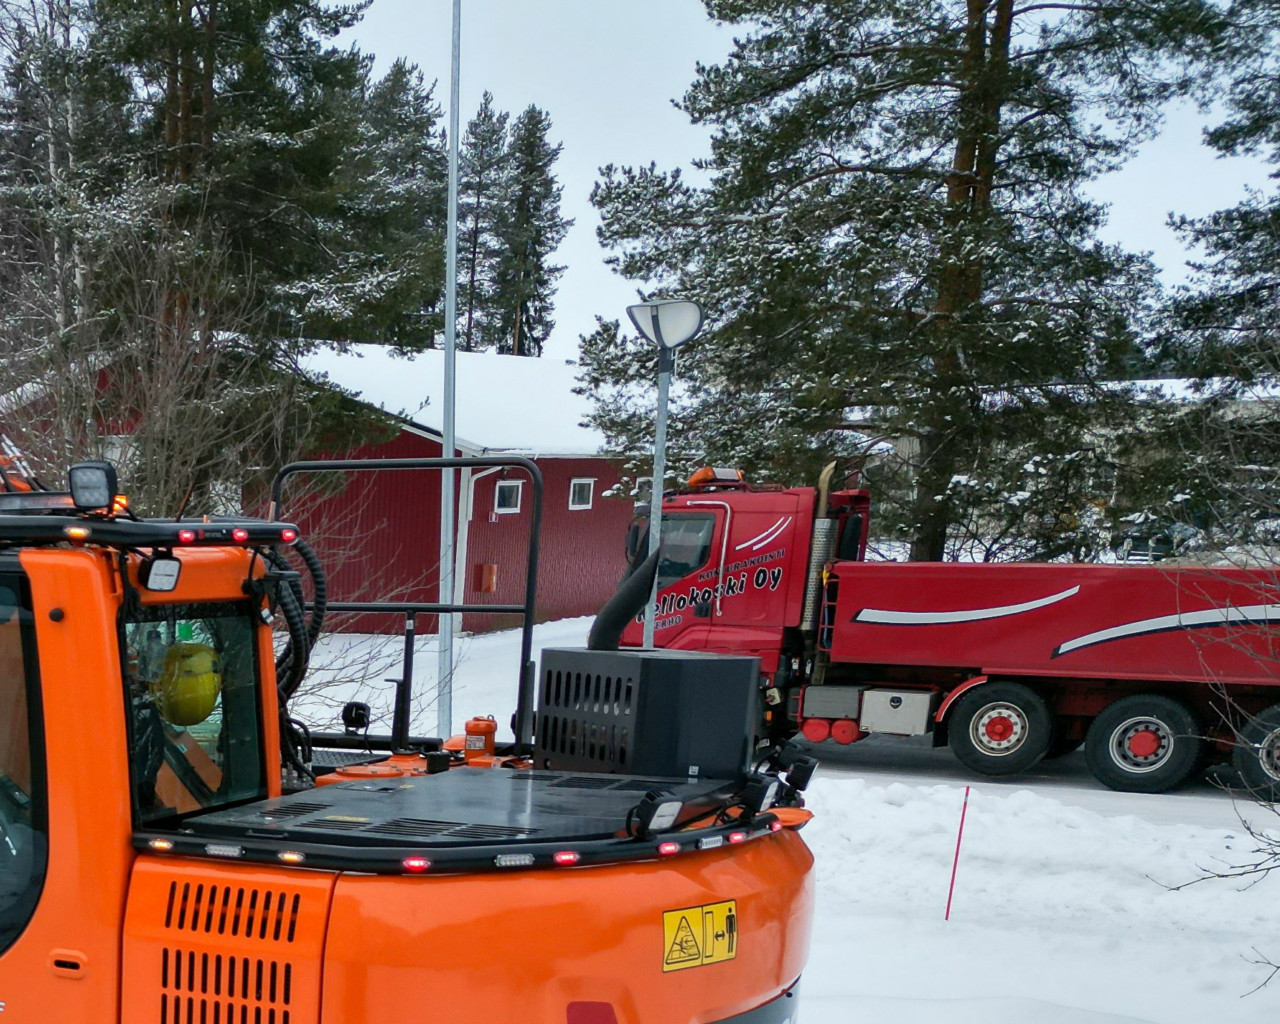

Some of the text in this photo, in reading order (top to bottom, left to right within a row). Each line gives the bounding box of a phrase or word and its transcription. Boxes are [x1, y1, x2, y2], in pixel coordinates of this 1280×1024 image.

[698, 548, 786, 582] KONURAKOINTI
[753, 566, 783, 591] Oy
[654, 614, 683, 632] ERHO
